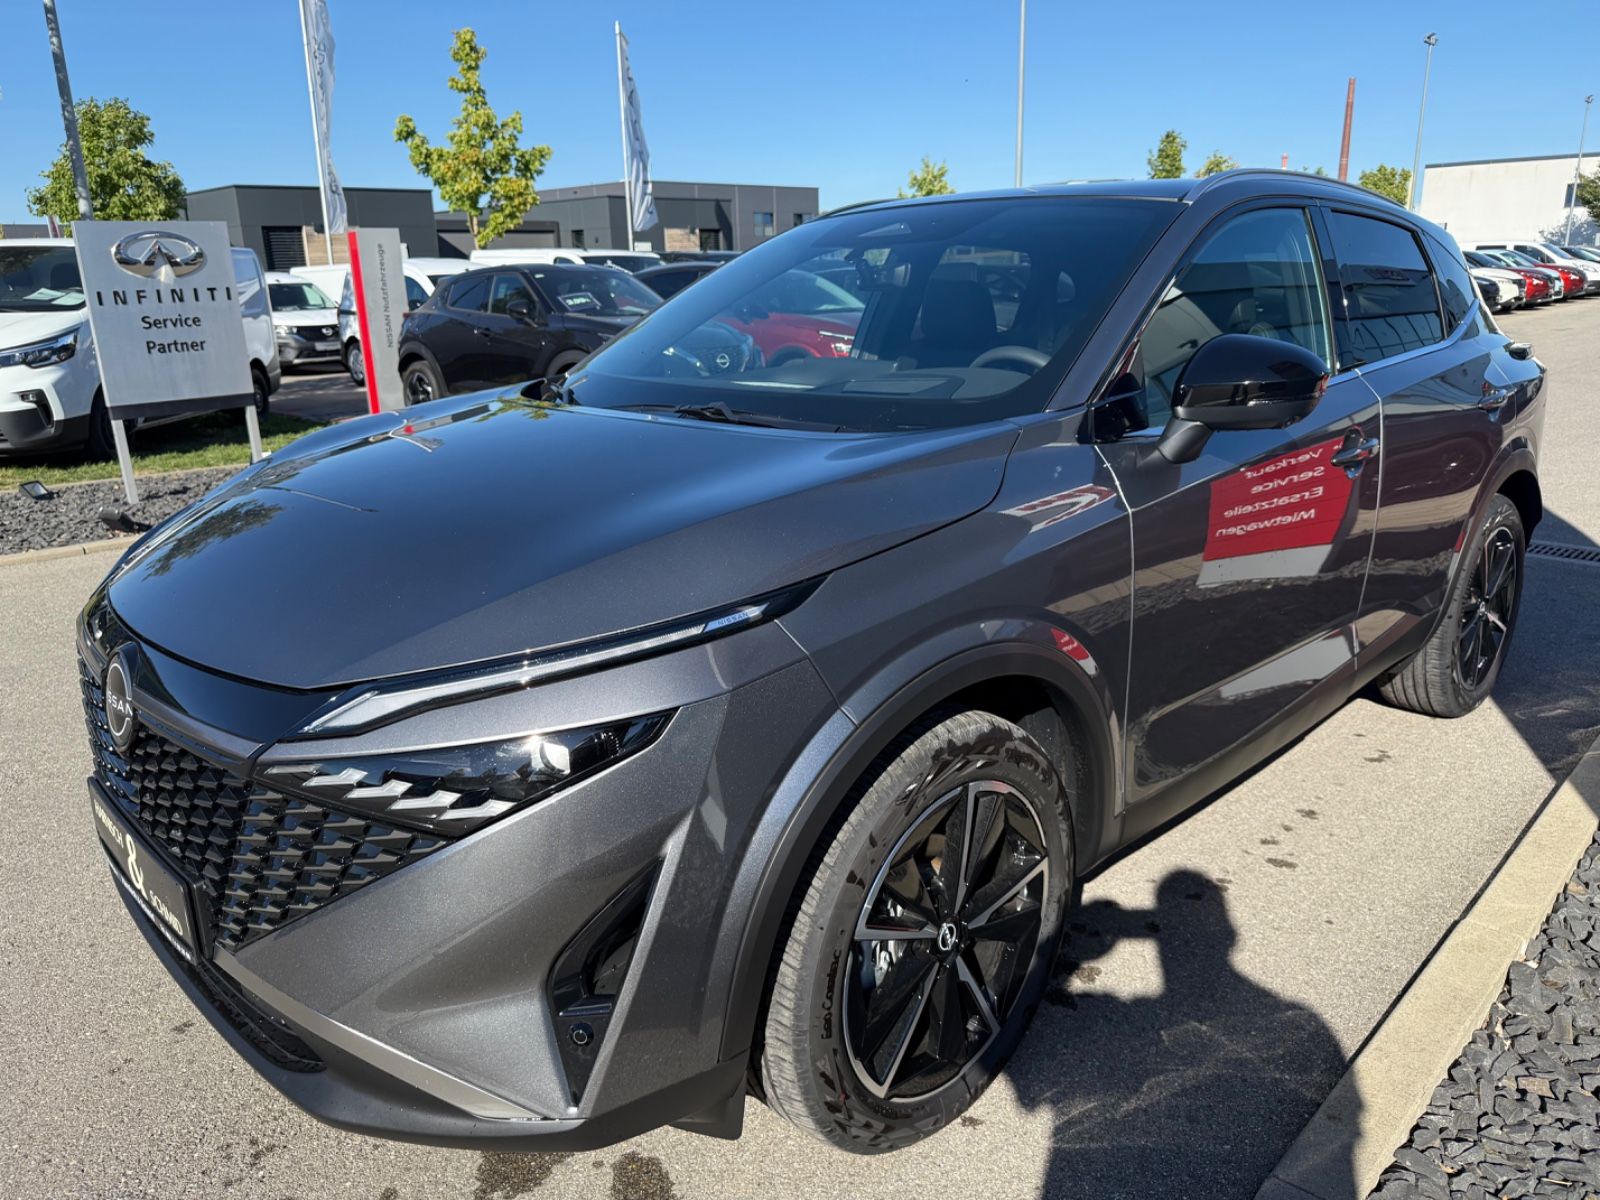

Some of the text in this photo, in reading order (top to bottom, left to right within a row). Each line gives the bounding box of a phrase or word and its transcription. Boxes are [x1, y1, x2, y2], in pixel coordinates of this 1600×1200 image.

[97, 287, 232, 306] INFINITI
[377, 243, 393, 348] NISSAN Nutzfahrzeuge
[141, 314, 201, 330] Service
[146, 340, 206, 354] Partner
[108, 691, 133, 716] SSAN
